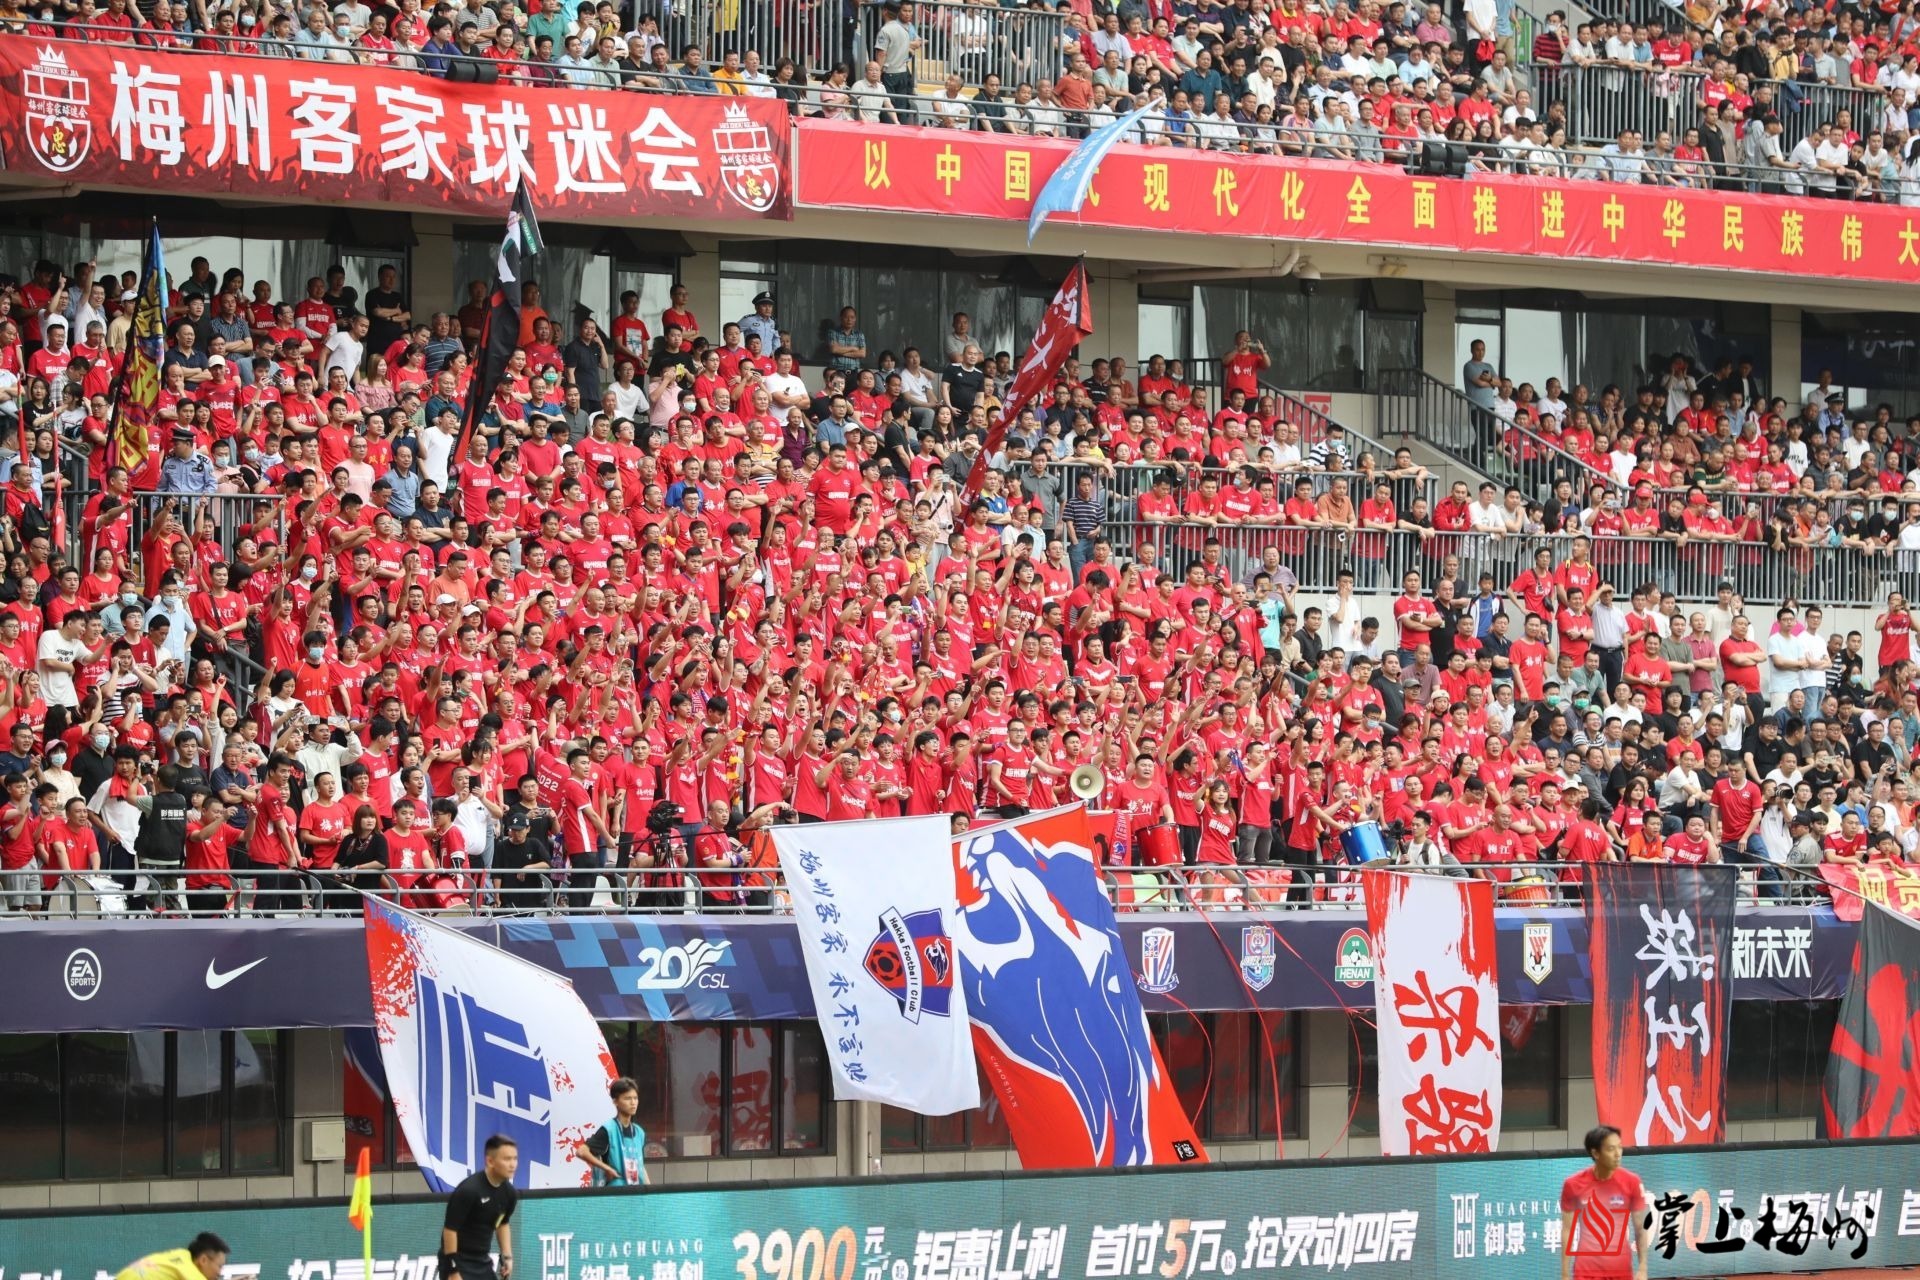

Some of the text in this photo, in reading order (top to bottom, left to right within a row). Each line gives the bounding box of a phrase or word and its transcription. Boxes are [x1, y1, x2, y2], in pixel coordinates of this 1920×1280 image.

[110, 60, 704, 197] 梅州客家球迷会
[70, 959, 96, 978] EA
[888, 917, 919, 1012] Hakka Football Club
[1339, 967, 1371, 979] HENAN
[70, 977, 97, 987] SPORTS
[698, 973, 730, 989] CSL
[1484, 1200, 1562, 1217] HUACHUA
[732, 1225, 858, 1280] 3900
[1240, 1208, 1420, 1273] 抢灵动四房
[1484, 1218, 1563, 1257] 御景·華
[579, 1237, 704, 1260] HUACHUANG
